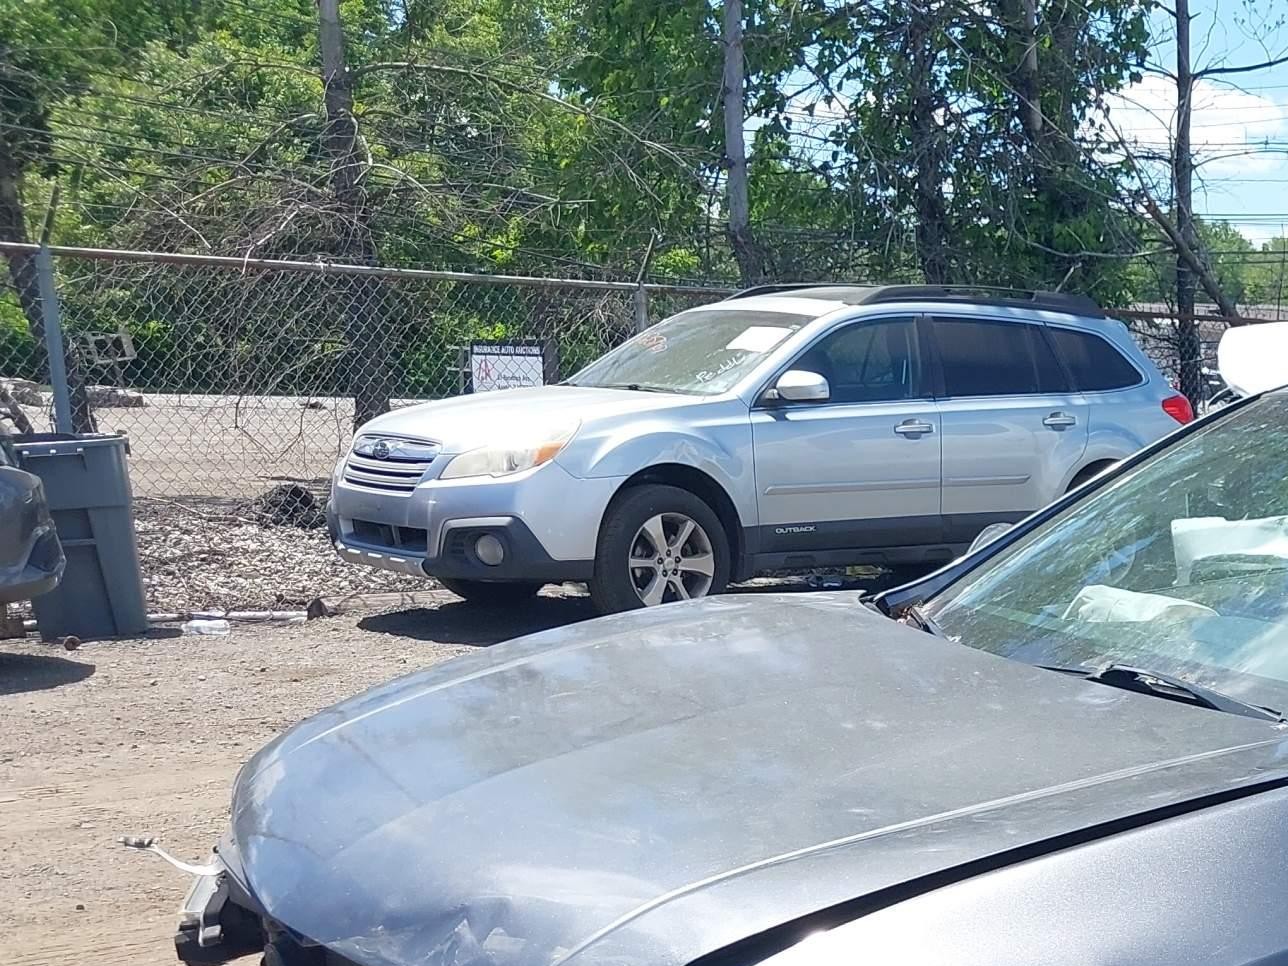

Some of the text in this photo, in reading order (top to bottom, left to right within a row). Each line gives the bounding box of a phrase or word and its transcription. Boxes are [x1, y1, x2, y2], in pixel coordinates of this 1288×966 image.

[473, 345, 541, 355] INSURANCE AUTO AUCTIONS
[775, 526, 817, 534] OUTBACK
